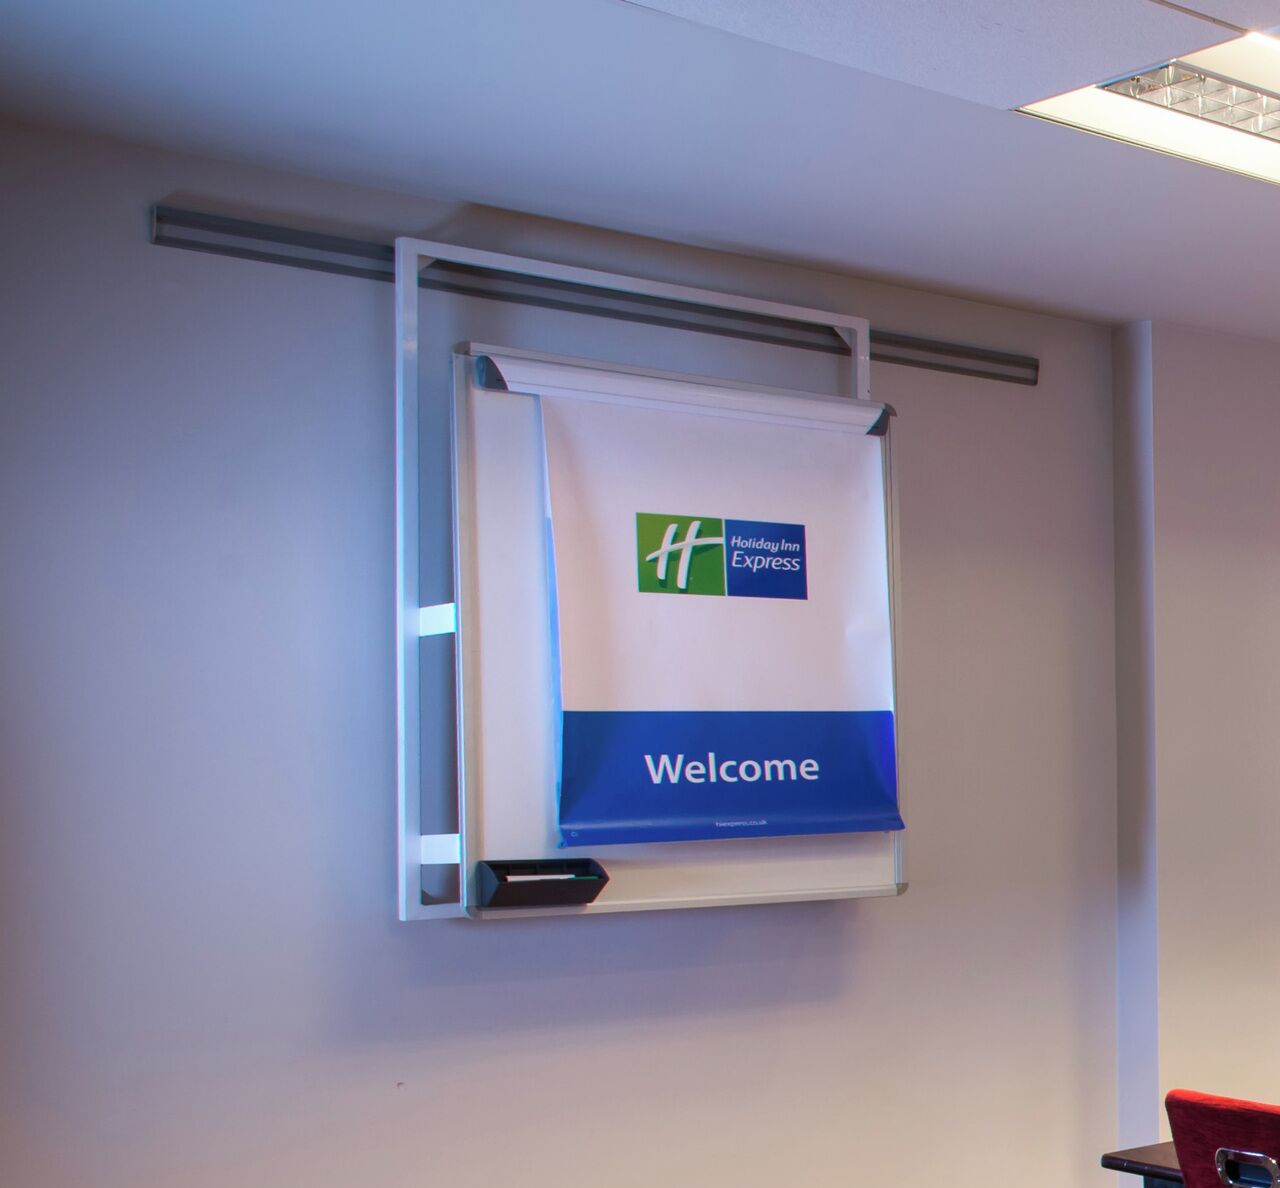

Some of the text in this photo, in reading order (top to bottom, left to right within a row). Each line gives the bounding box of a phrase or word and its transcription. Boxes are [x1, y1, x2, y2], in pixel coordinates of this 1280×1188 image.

[731, 535, 800, 553] Holiday Inn
[731, 551, 801, 573] Express
[644, 752, 820, 784] Welcome
